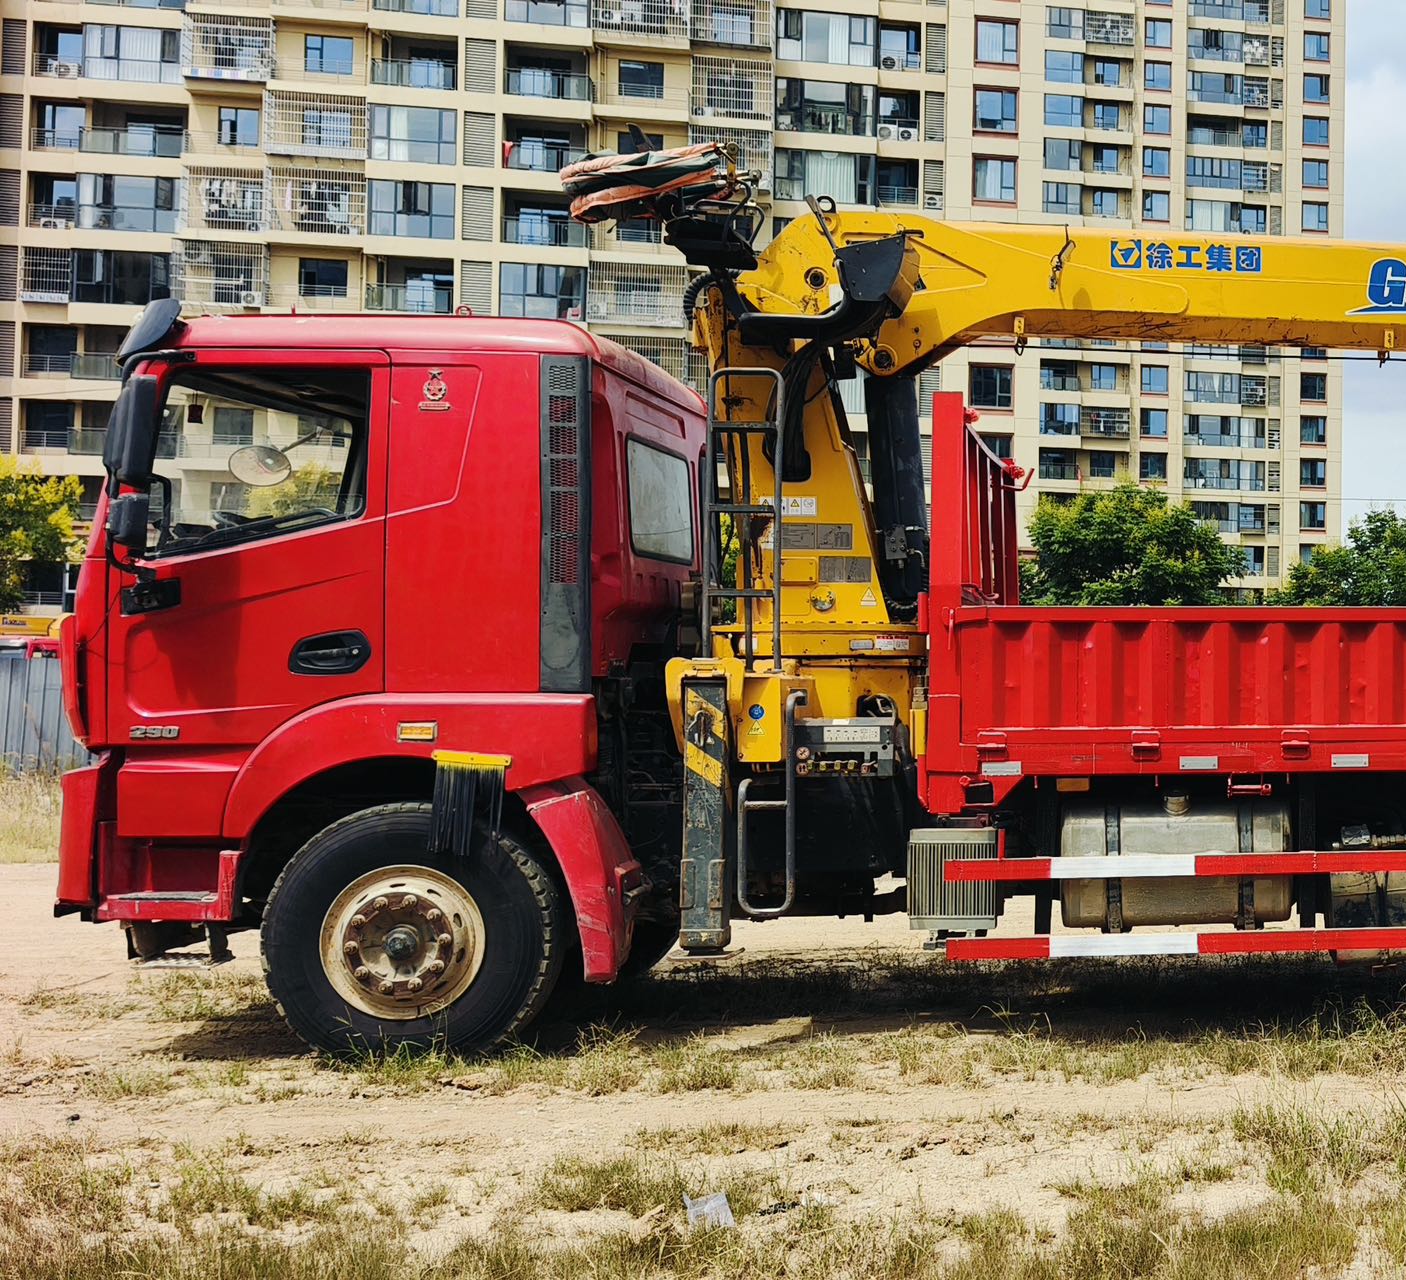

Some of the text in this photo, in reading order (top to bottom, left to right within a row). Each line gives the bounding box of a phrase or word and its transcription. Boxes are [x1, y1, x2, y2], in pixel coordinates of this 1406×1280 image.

[1146, 242, 1261, 272] 徐工集团
[129, 726, 179, 739] 290
